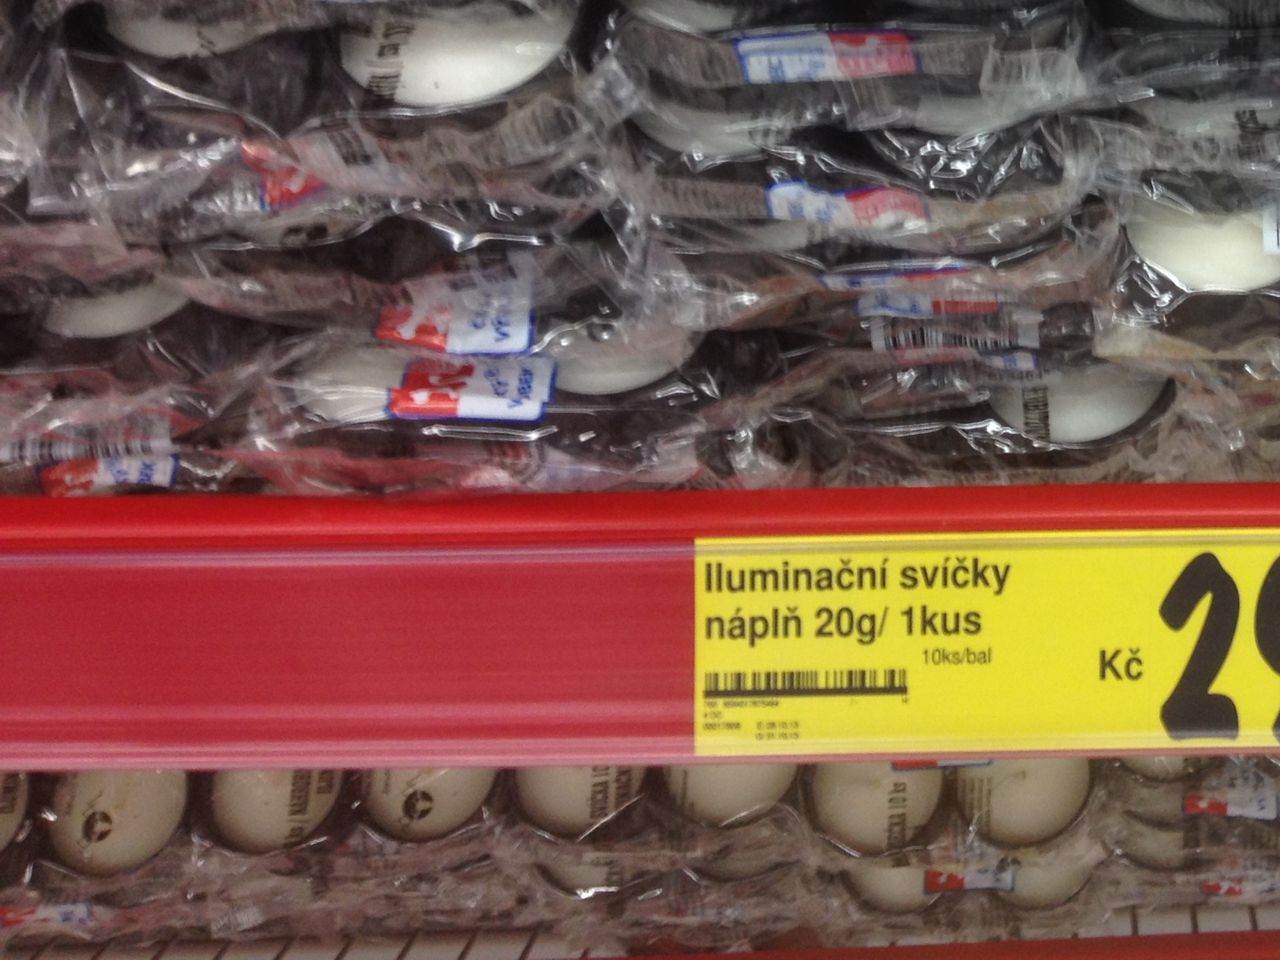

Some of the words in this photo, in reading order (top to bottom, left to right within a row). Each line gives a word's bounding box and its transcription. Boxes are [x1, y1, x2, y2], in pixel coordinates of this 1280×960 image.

[704, 559, 889, 593] Iluminační
[899, 557, 1011, 596] svíčky
[704, 605, 802, 647] náplň
[815, 605, 888, 644] 20g/
[902, 604, 982, 637] 1kus
[923, 647, 992, 666] 10ks/bal
[1099, 648, 1144, 681] Kč
